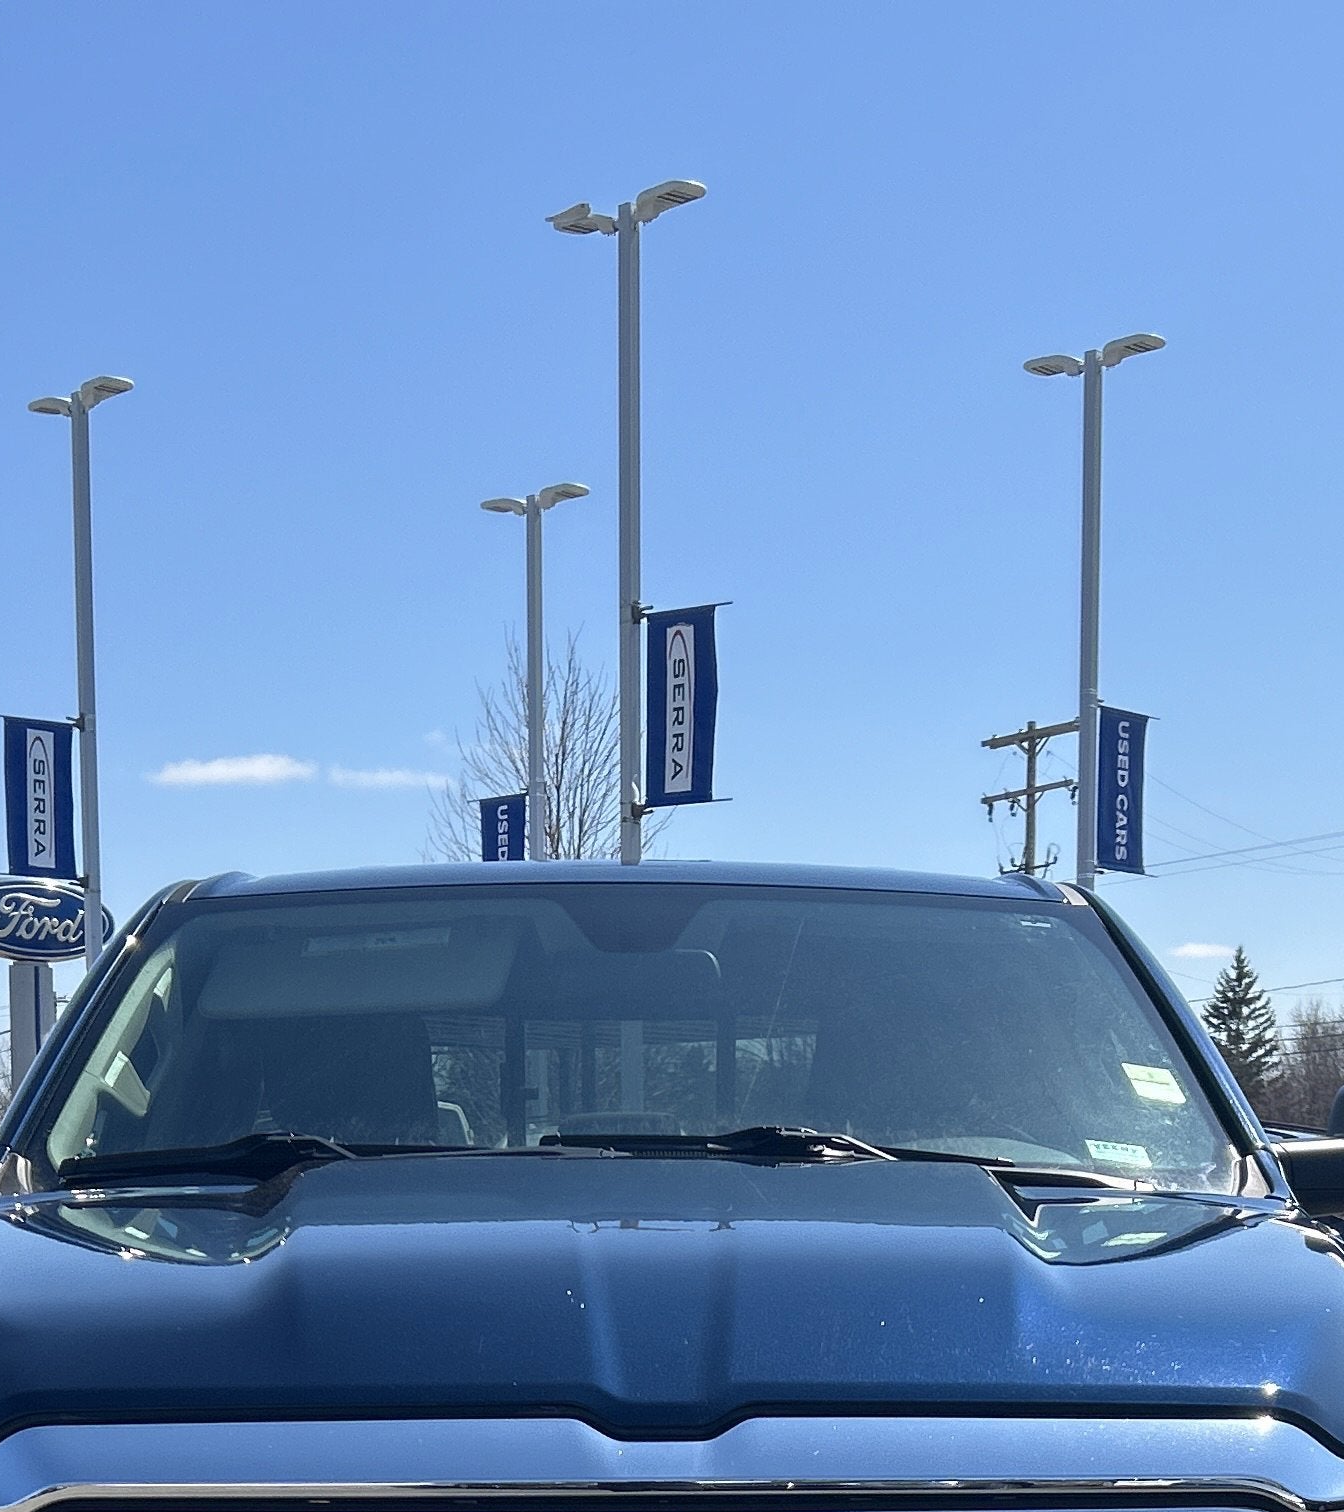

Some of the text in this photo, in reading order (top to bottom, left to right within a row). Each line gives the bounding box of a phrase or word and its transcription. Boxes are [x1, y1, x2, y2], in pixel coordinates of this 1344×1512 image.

[670, 658, 685, 782] SERRA
[32, 758, 46, 857] SERRA
[497, 804, 509, 861] USED
[1115, 721, 1130, 861] USED CARS
